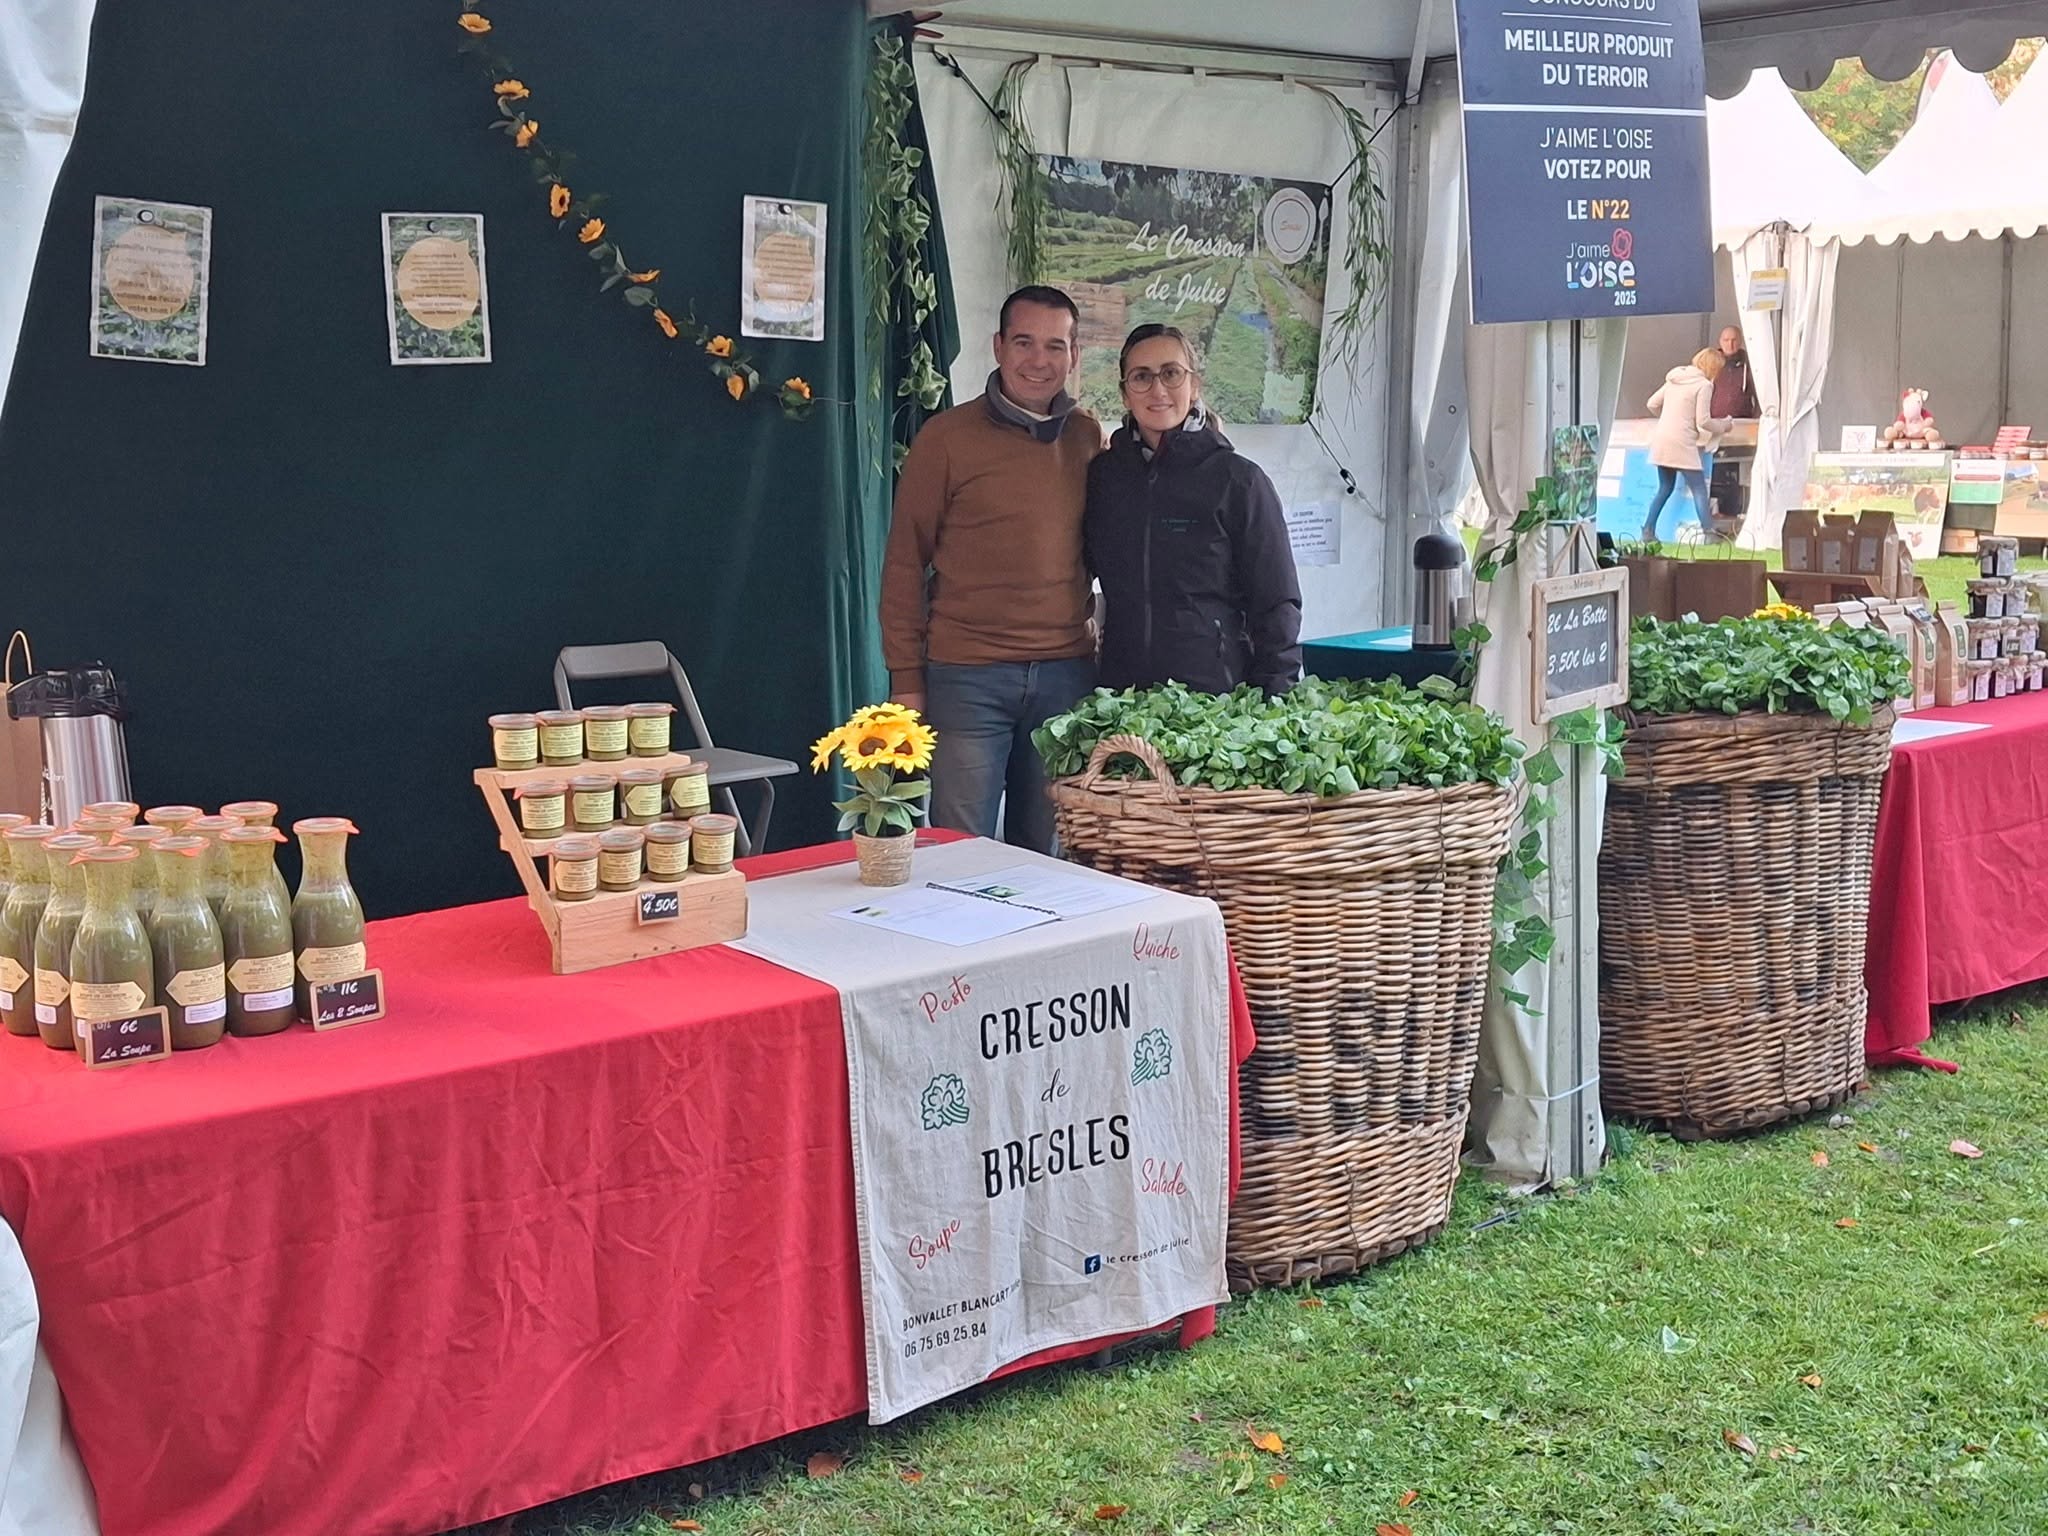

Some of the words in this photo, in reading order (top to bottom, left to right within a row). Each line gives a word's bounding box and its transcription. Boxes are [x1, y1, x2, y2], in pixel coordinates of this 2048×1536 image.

[1505, 28, 1600, 54] MEILLEUR
[1604, 35, 1674, 58] PRODUIT
[1542, 63, 1570, 85] DU
[1575, 65, 1649, 88] TERROIR
[1540, 127, 1598, 149] J'AIME
[1603, 129, 1653, 150] L'OISE
[1544, 158, 1601, 179] VOTEZ
[1606, 159, 1651, 179] POUR
[1567, 200, 1587, 220] LE
[1592, 199, 1630, 220] N°22
[1126, 221, 1157, 252] Le
[1166, 223, 1246, 260] Cresson
[1566, 242, 1611, 259] J'aime
[1145, 274, 1169, 301] de
[1174, 272, 1230, 313] Julie
[1614, 291, 1636, 306] 2025
[1547, 613, 1562, 634] 2€
[1563, 608, 1579, 631] La
[1582, 604, 1608, 627] Botte
[1582, 647, 1595, 667] les
[1599, 641, 1608, 662] 2
[1132, 921, 1180, 961] Quiche
[340, 981, 358, 996] 11€
[918, 973, 972, 1023] Pesto
[346, 1003, 377, 1017] Soupes
[980, 982, 1131, 1060] CRESSON
[120, 1020, 138, 1034] 6€
[100, 1047, 117, 1059] La
[120, 1044, 152, 1057] Soupe
[1041, 1068, 1071, 1103] de
[980, 1114, 1130, 1199] BRESLES
[1140, 1158, 1187, 1195] Salade
[908, 1218, 961, 1270] Soupe
[1106, 1255, 1116, 1264] le
[1120, 1247, 1158, 1263] cresson
[903, 1302, 958, 1332] BONVALLET
[961, 1286, 1009, 1314] BLANCART
[904, 1321, 988, 1359] 06.75.69.25.84
